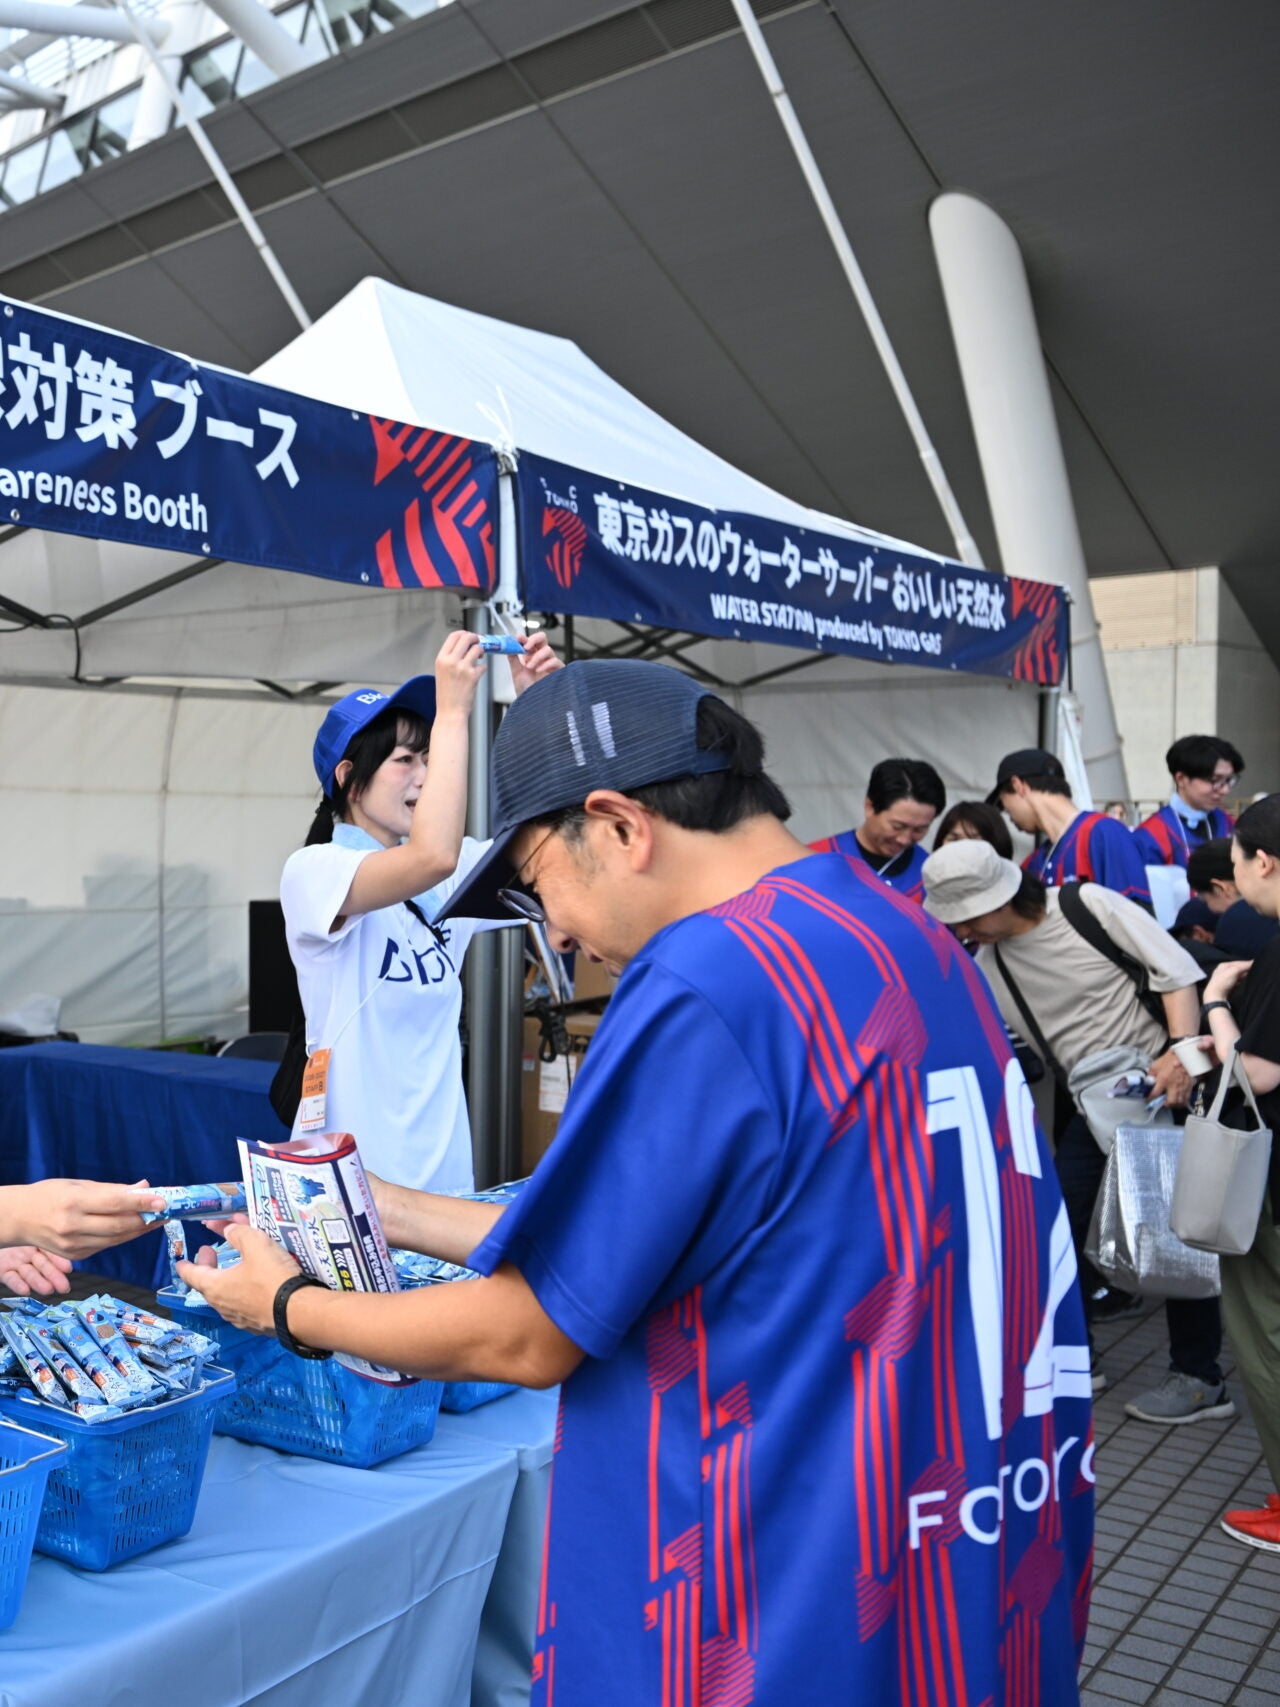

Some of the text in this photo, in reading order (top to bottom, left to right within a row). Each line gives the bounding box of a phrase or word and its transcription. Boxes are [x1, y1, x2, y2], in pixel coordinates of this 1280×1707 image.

[151, 379, 300, 489] ブース
[124, 481, 209, 533] Booth
[710, 593, 761, 625] WATER
[815, 615, 870, 642] produced
[869, 620, 884, 650] by
[882, 625, 921, 652] TOKYO
